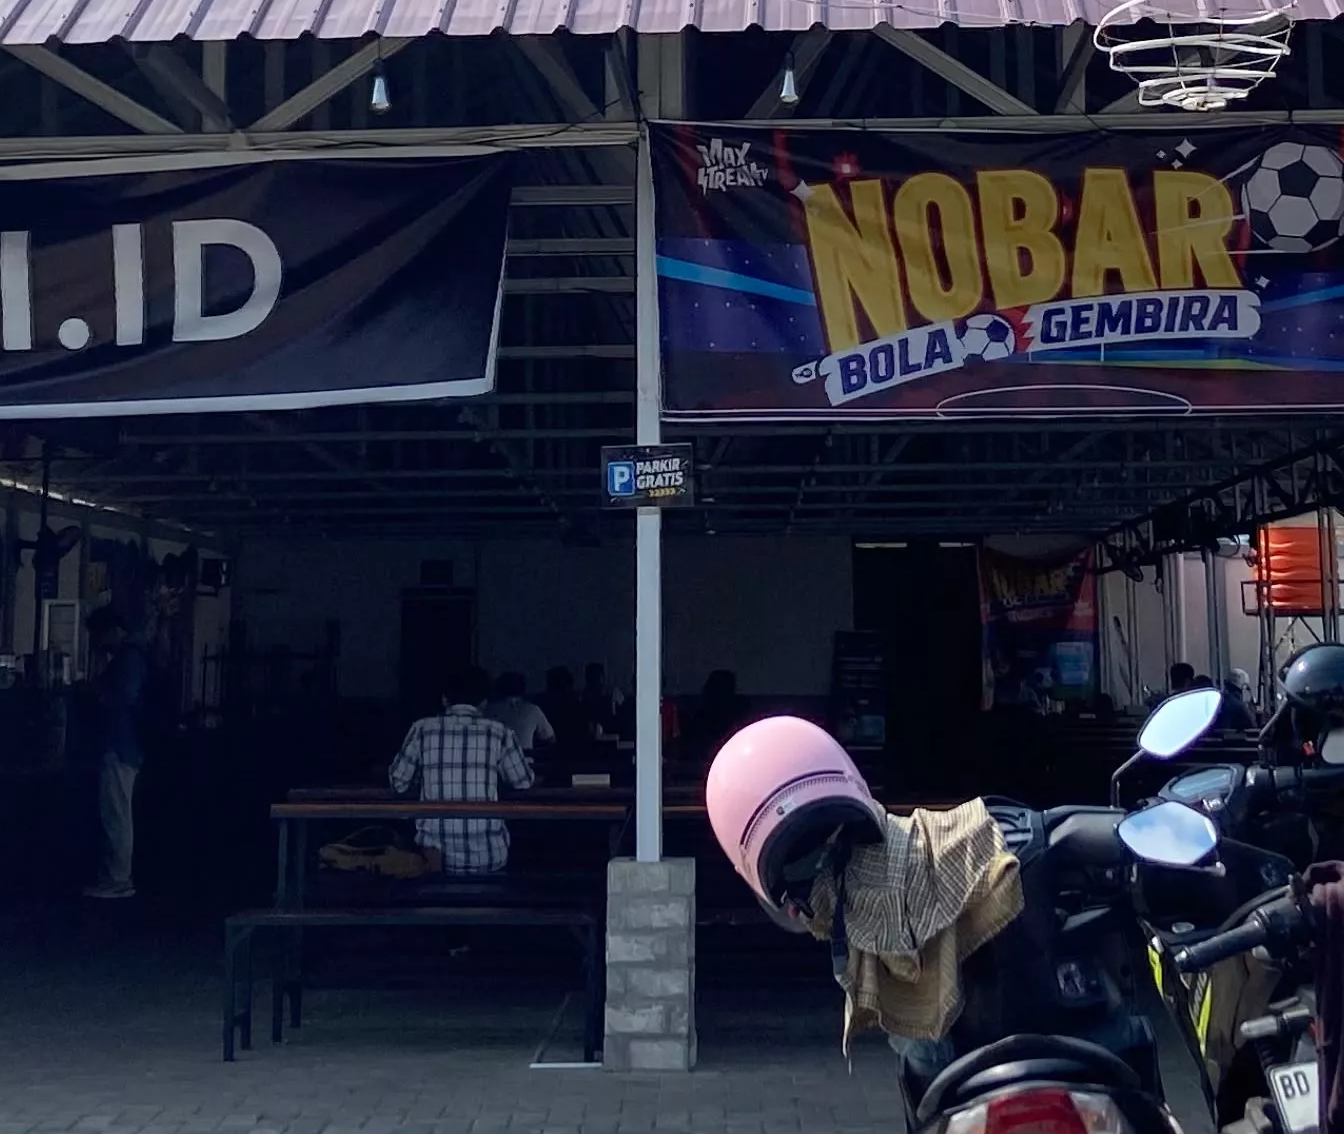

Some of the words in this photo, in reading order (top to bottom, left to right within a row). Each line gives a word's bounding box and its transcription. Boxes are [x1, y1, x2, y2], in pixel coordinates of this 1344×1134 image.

[696, 138, 751, 169] MAX
[803, 168, 1243, 356] NOBAR
[1040, 295, 1238, 344] GEMBIRA
[837, 328, 953, 395] BOLA
[636, 458, 680, 475] PARKIR
[636, 471, 683, 490] GRATIS
[1279, 1071, 1310, 1099] BD
